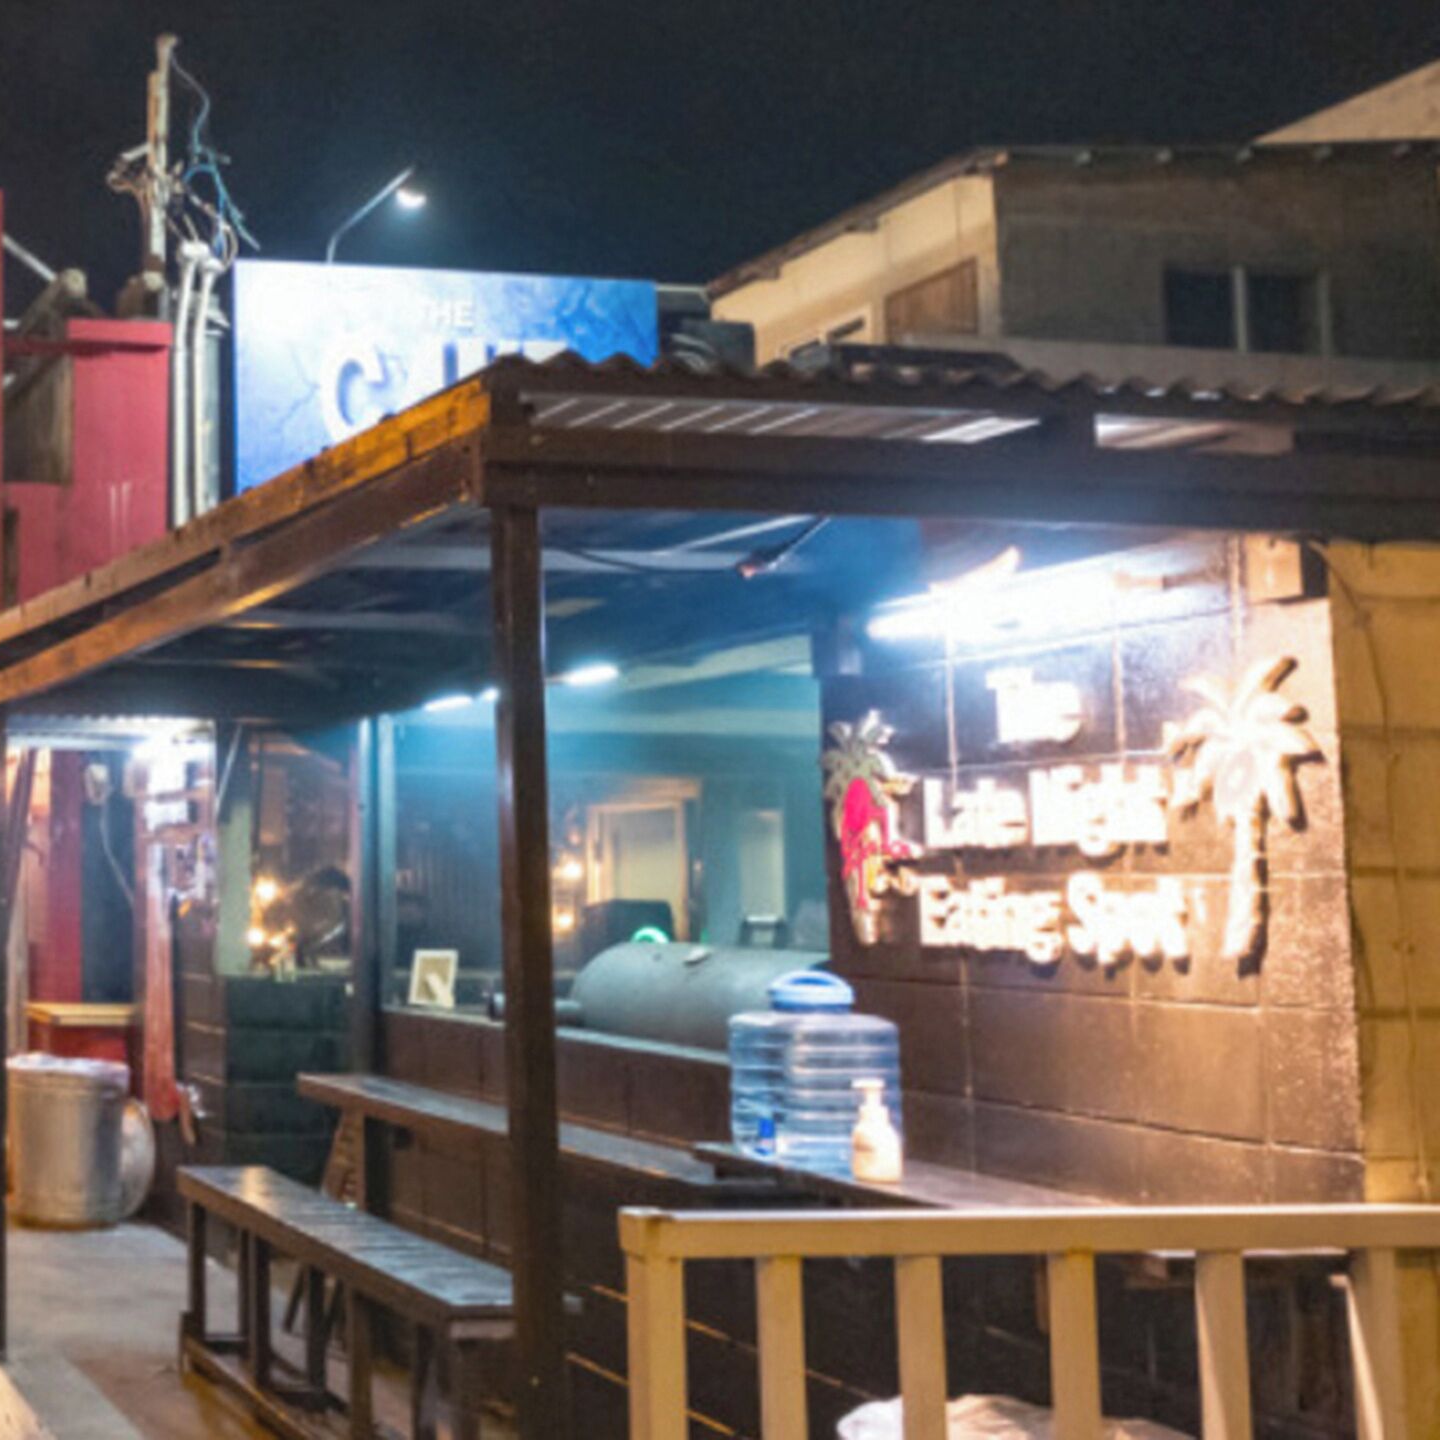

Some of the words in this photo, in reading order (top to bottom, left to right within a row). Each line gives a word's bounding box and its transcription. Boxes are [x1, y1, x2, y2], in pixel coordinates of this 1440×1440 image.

[421, 298, 474, 328] THE
[986, 667, 1082, 743] The
[924, 779, 1026, 847] Late
[1030, 764, 1166, 856] Night
[919, 876, 1061, 962] Eating
[1067, 873, 1187, 963] Spot
